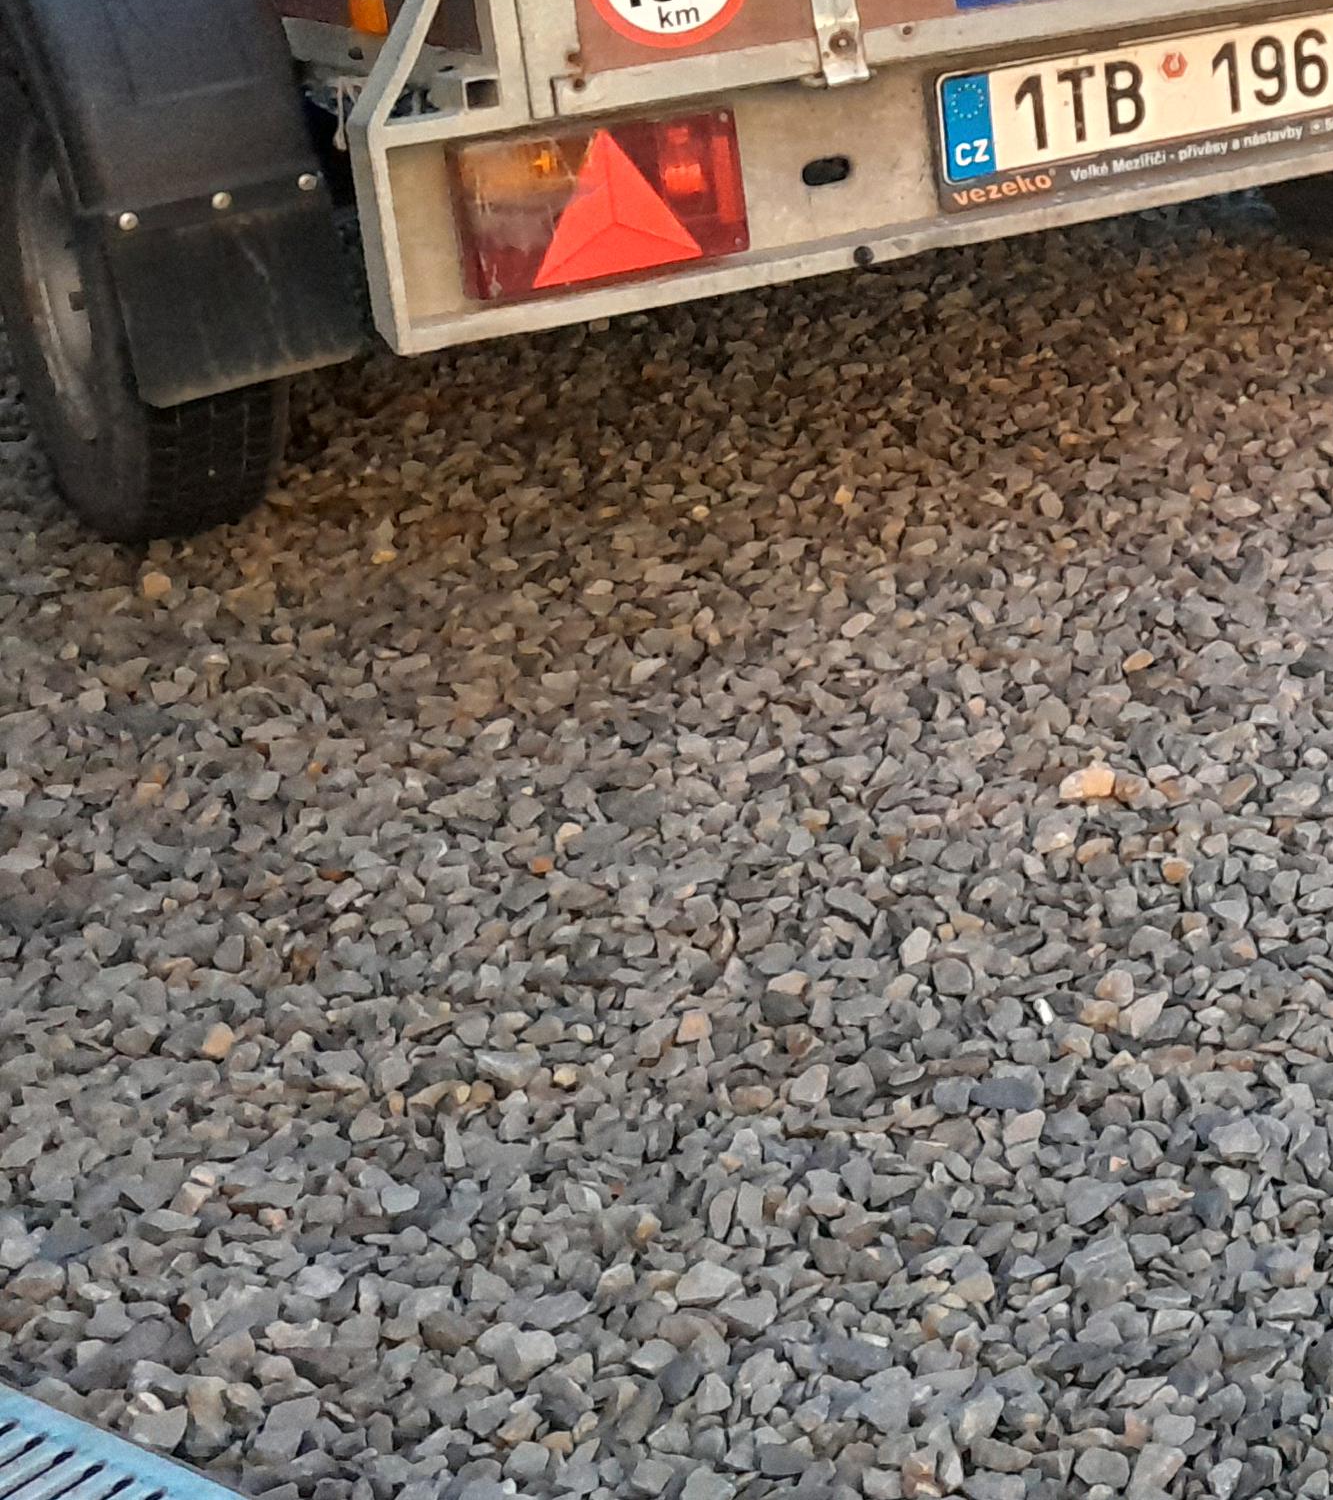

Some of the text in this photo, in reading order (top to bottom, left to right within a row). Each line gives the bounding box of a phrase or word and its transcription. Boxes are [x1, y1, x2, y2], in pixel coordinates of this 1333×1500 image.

[658, 6, 700, 29] km
[955, 139, 990, 167] CZ
[1015, 59, 1146, 150] 1TB
[952, 173, 1053, 206] vezeko
